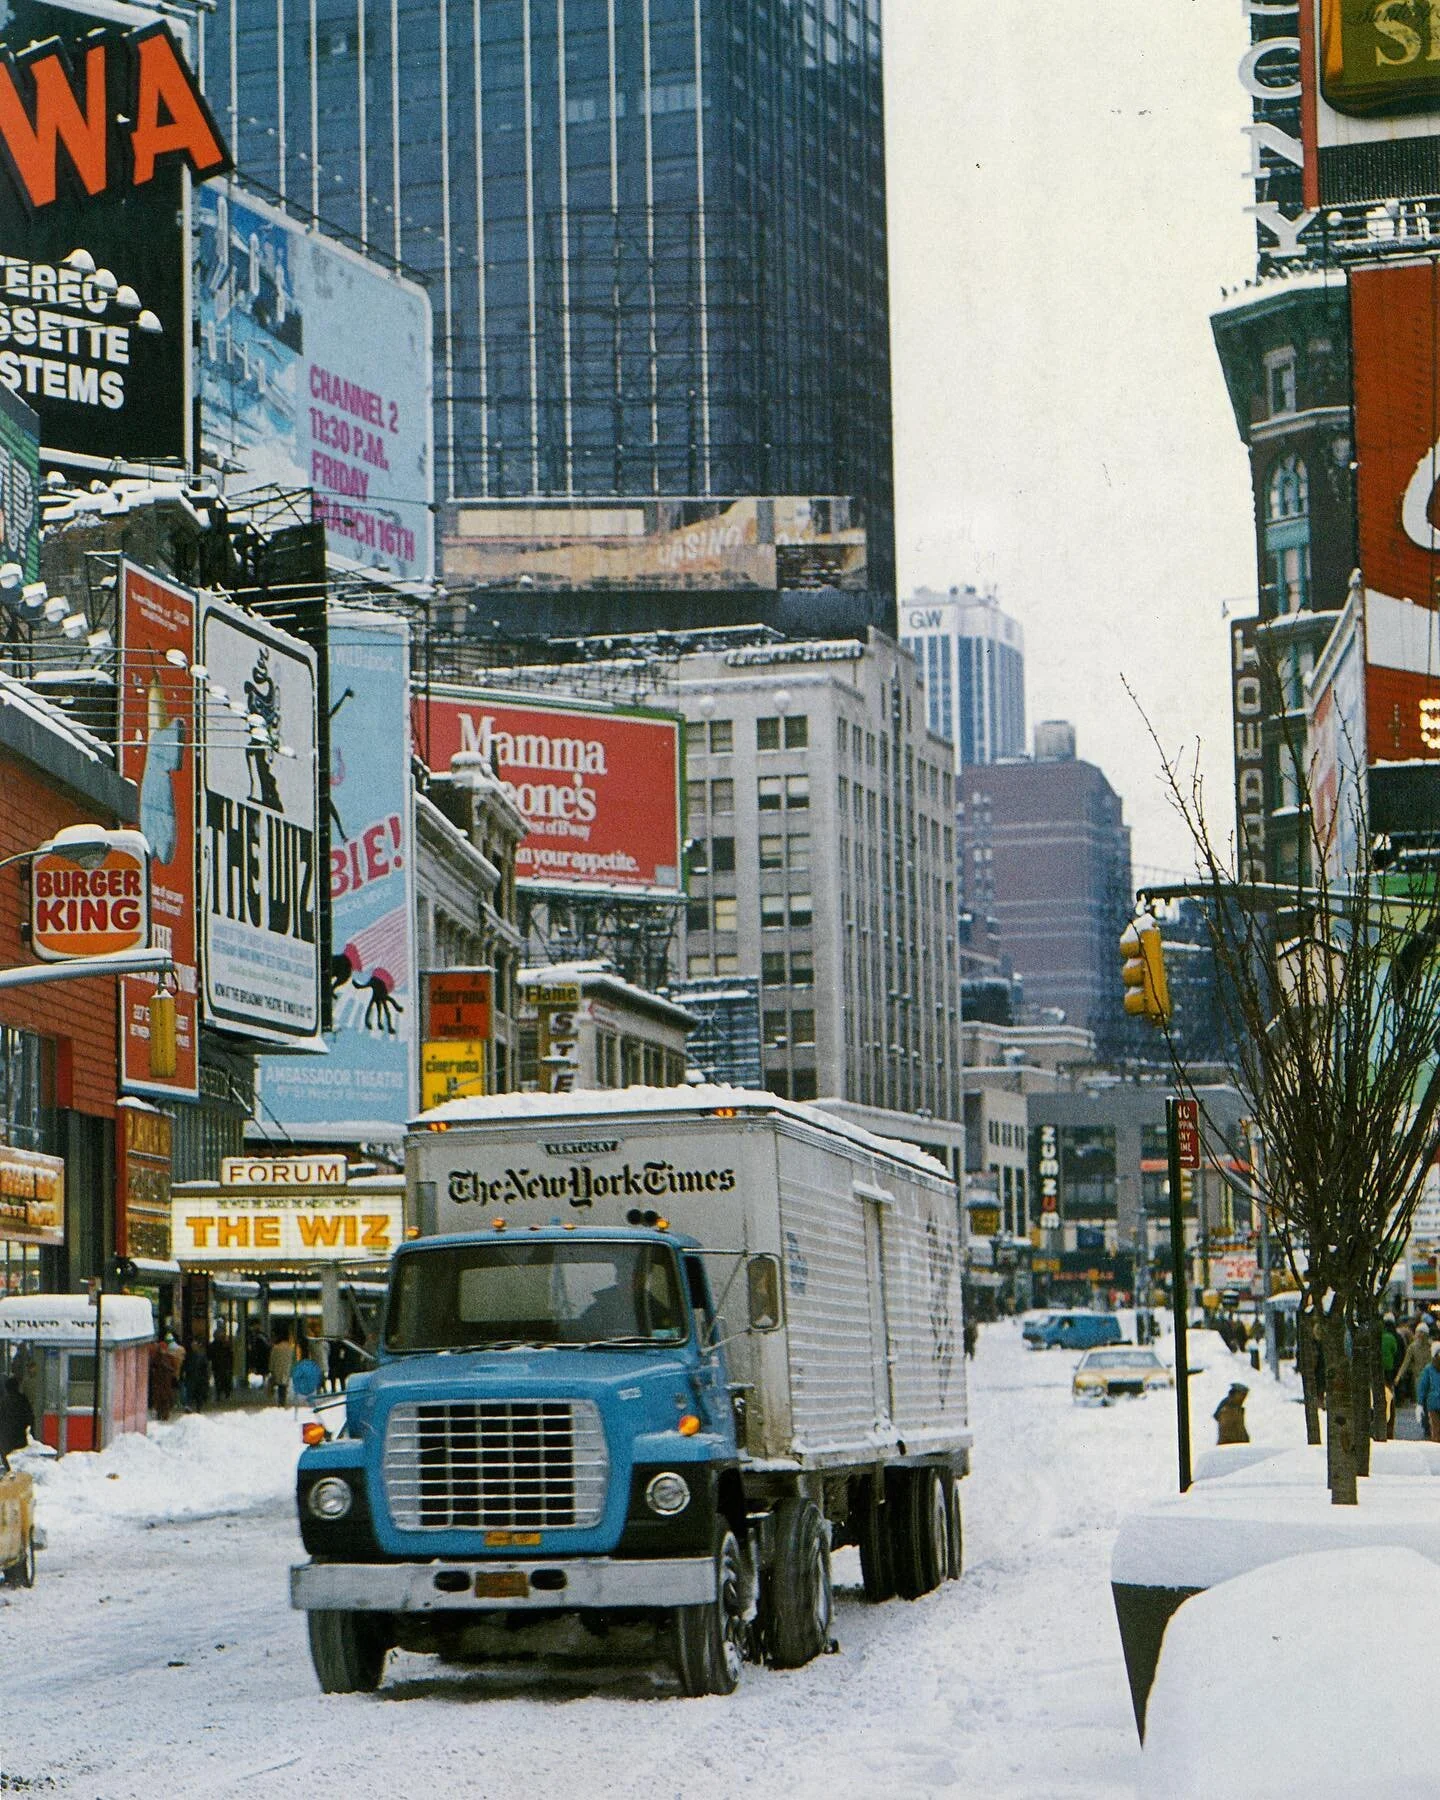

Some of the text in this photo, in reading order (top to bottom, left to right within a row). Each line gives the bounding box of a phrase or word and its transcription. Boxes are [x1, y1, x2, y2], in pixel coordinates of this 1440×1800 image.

[0, 256, 108, 314] EREO
[309, 363, 399, 435] CHANNEL 2
[309, 406, 350, 455] 11:30
[312, 449, 369, 503] FRIDAY
[313, 490, 415, 562] MARCH 16TH
[909, 609, 943, 629] GW
[458, 713, 608, 776] Mamma
[206, 789, 262, 928] THE
[533, 847, 571, 870] your
[571, 849, 640, 873] appetite.
[36, 870, 142, 898] BURGER
[36, 899, 141, 932] KING
[526, 984, 578, 1002] Flame
[264, 1065, 352, 1086] AMBASSADOR
[229, 1163, 339, 1183] FORUM
[449, 1160, 737, 1209] The New York Times
[186, 1214, 392, 1248] THE WIZ
